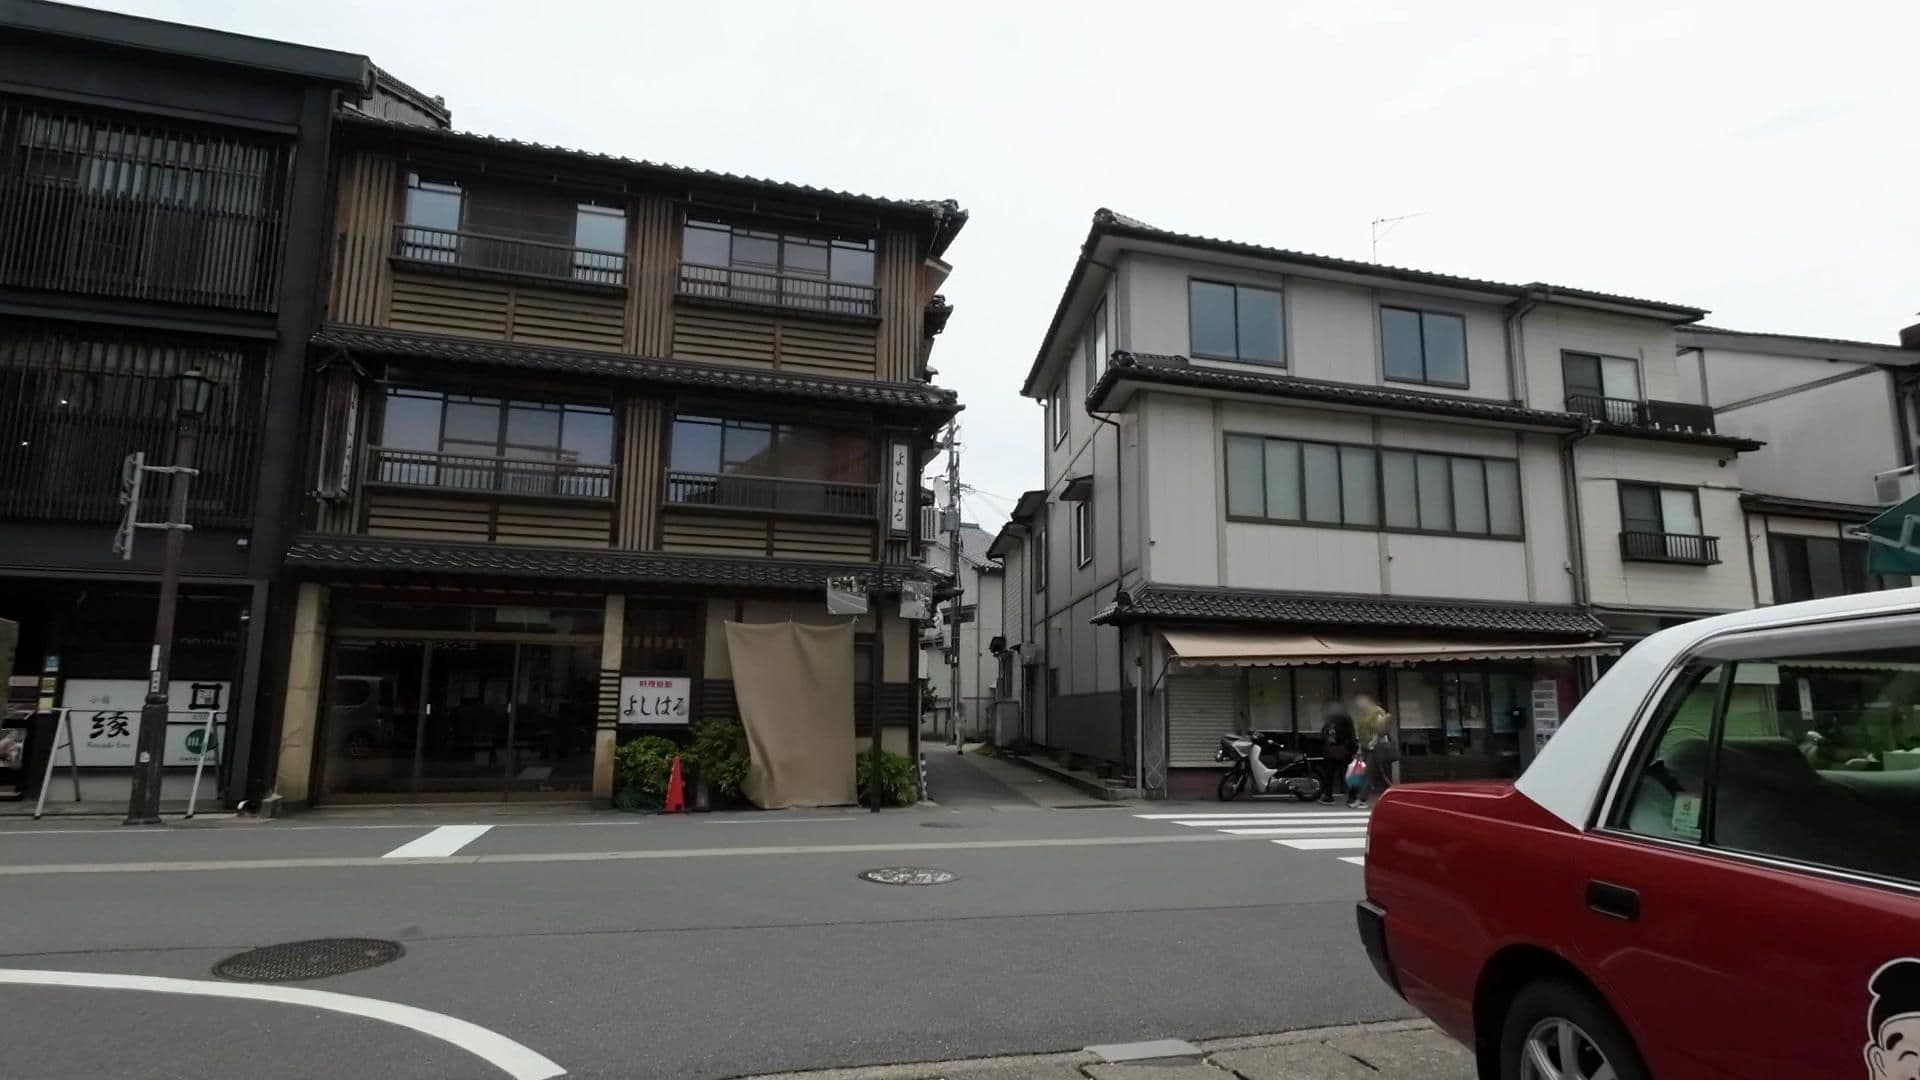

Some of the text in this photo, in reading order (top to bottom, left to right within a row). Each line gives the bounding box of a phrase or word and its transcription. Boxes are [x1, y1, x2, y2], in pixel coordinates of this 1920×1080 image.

[893, 452, 905, 522] よしはる
[623, 694, 686, 717] よしはる
